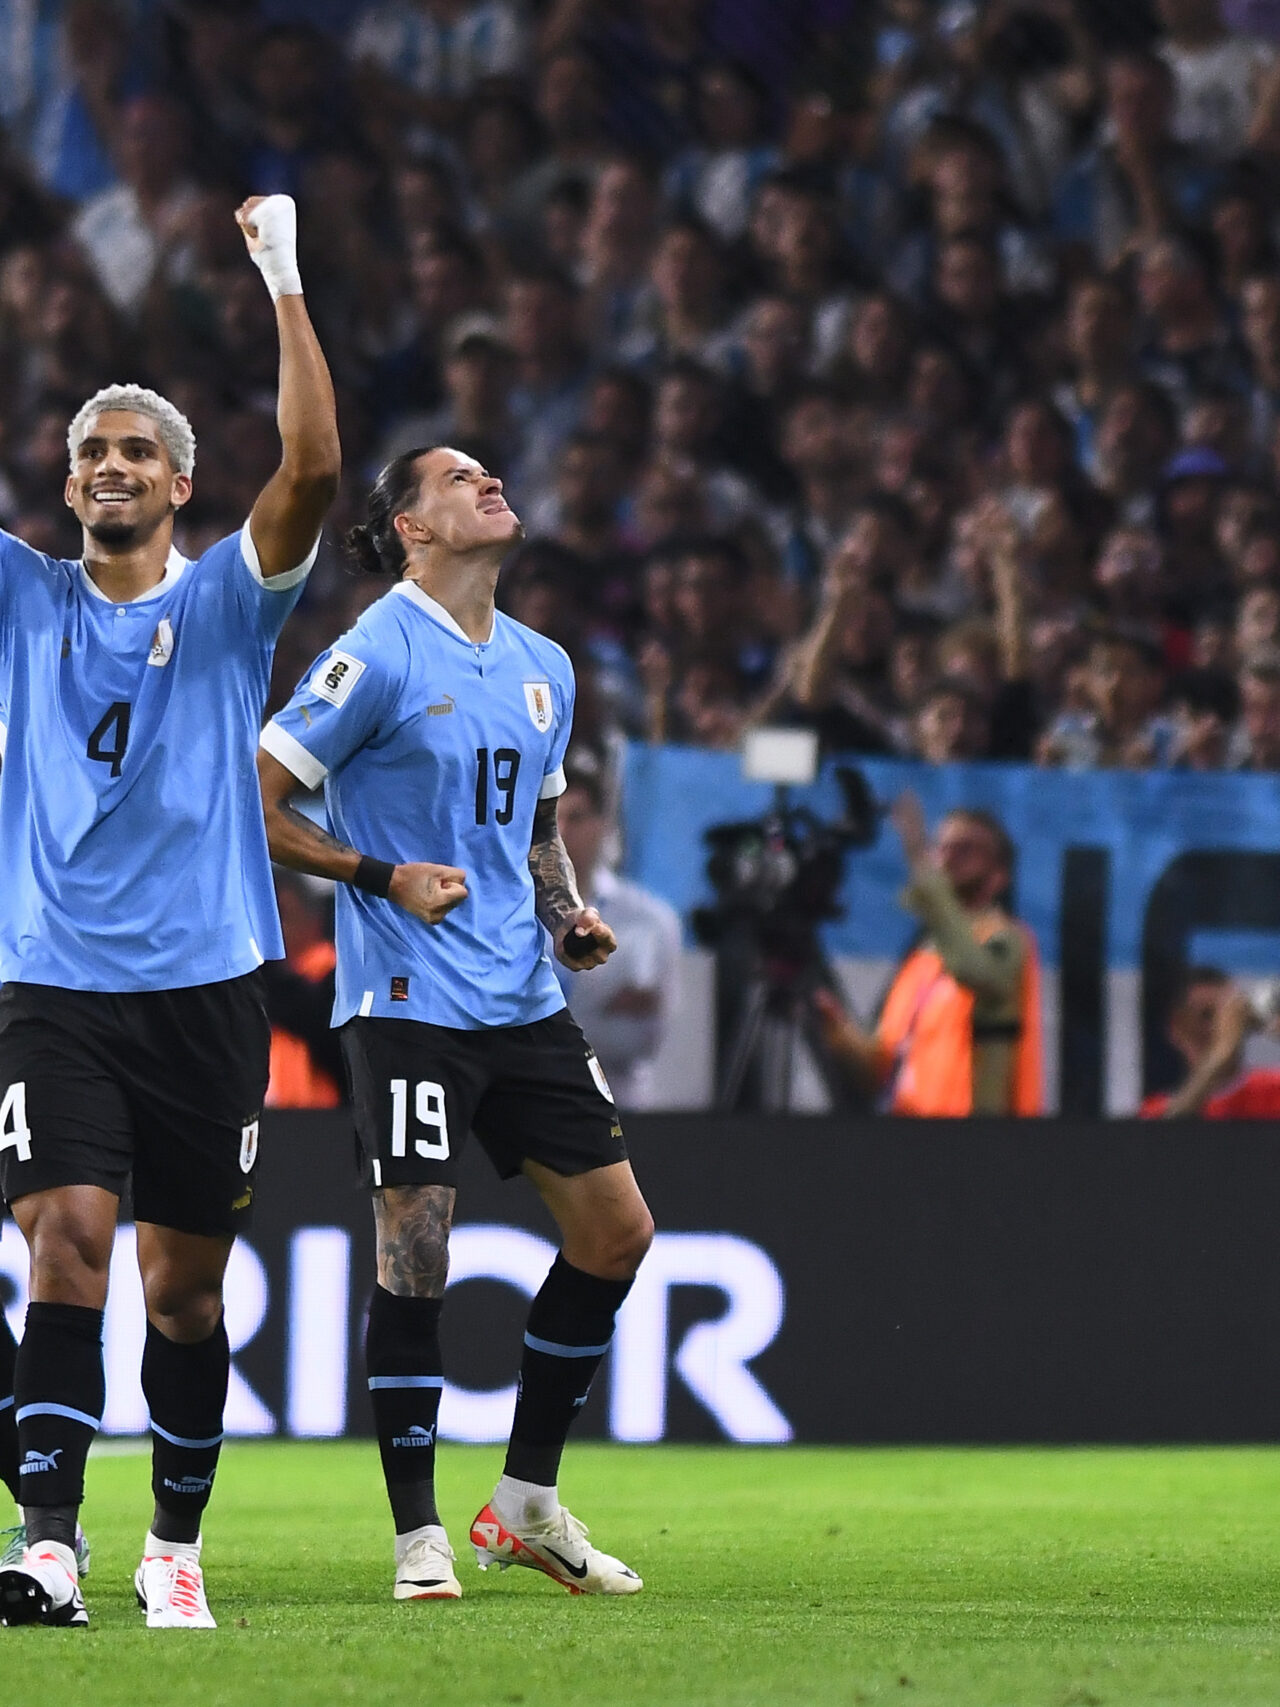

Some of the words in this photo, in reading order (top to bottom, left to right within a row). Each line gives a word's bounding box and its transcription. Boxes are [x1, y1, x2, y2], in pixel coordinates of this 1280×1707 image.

[87, 701, 131, 778] 4
[475, 747, 521, 826] 19
[390, 1079, 450, 1161] 19
[392, 1436, 430, 1448] PUMA
[163, 1477, 206, 1493] PUMA
